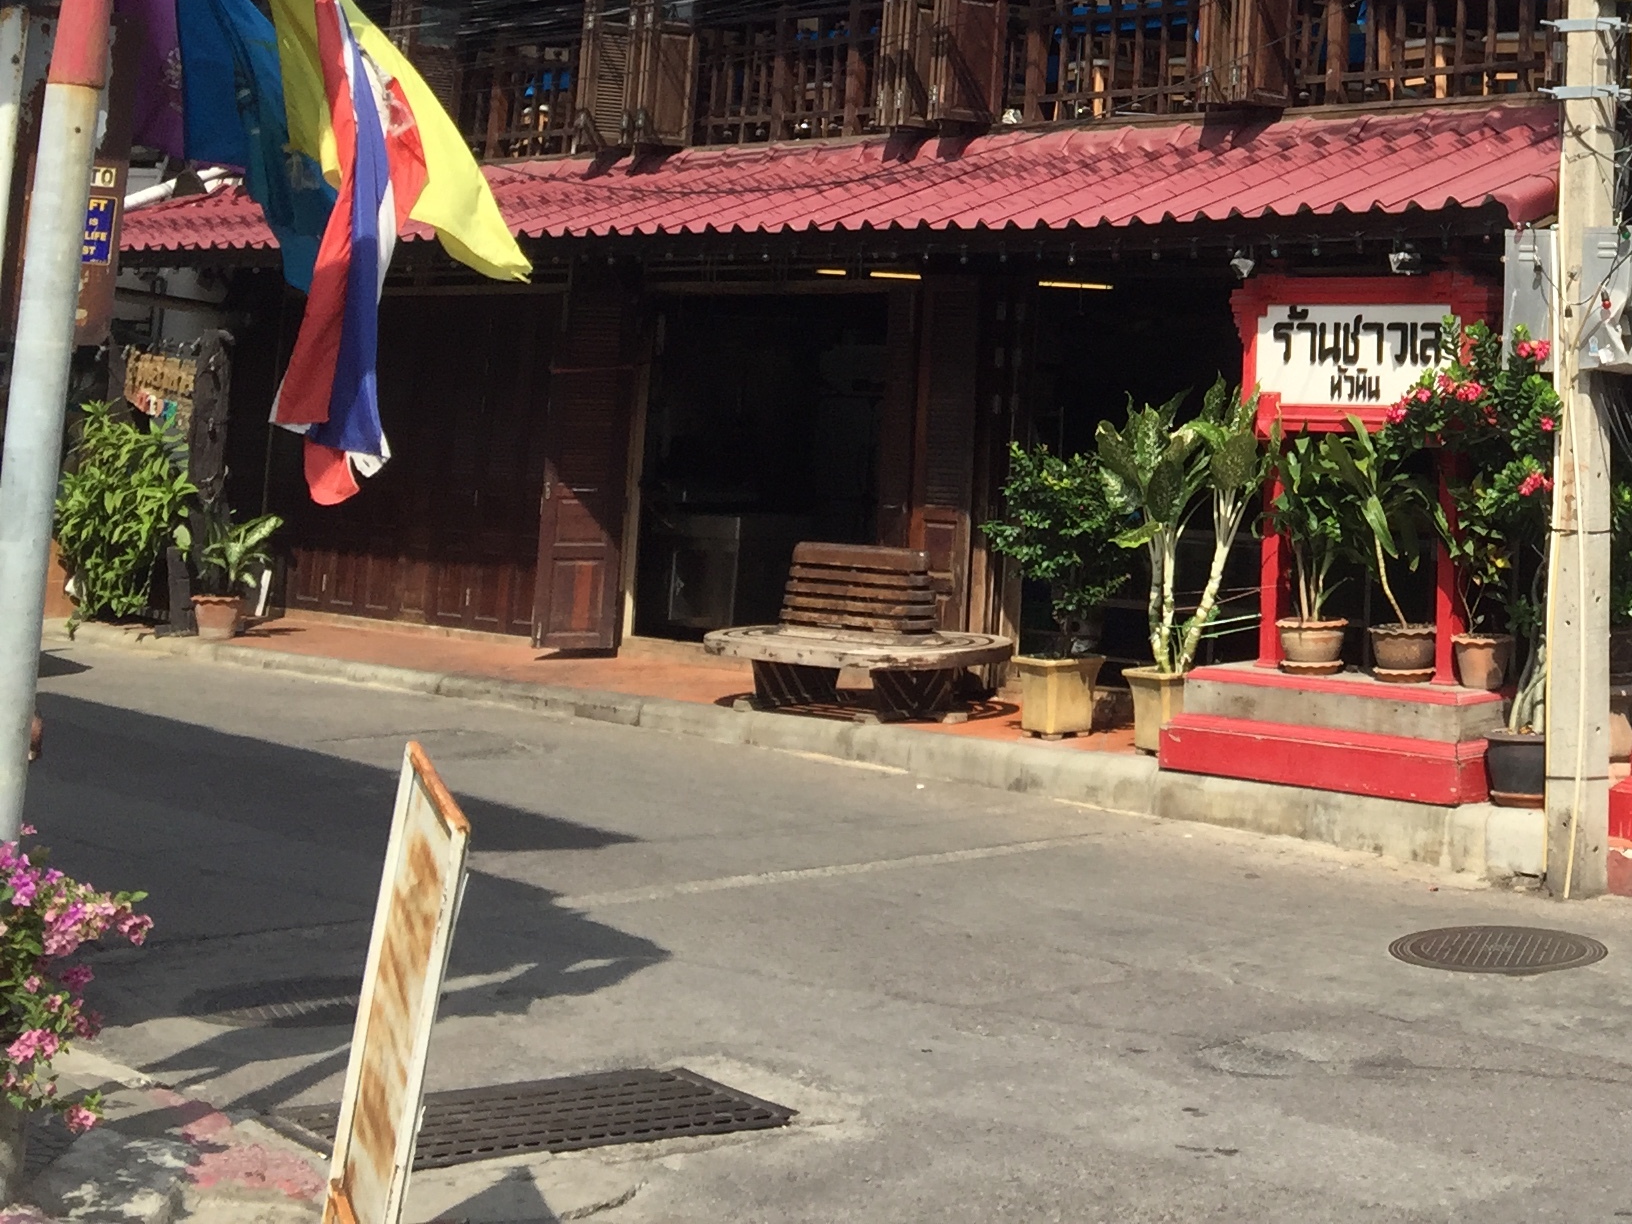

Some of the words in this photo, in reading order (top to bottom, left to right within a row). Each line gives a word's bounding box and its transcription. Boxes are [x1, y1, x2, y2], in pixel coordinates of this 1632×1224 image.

[1272, 304, 1442, 366] ร้านชาวเล
[1330, 365, 1382, 402] หัวหิน
